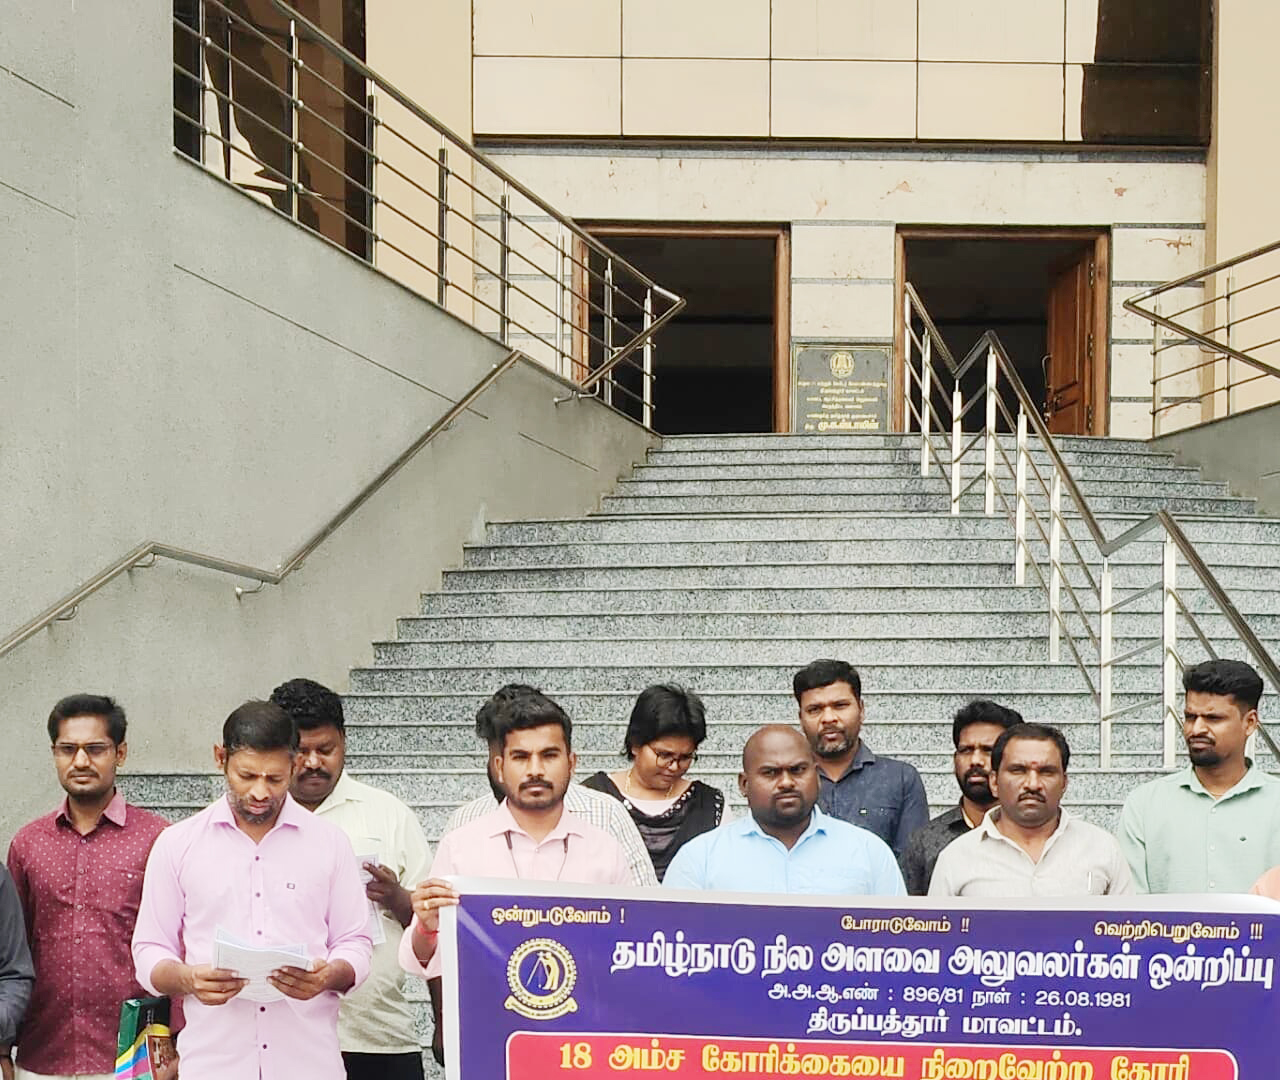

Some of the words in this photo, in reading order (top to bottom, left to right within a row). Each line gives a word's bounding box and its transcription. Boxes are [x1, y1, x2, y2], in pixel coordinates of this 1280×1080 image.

[492, 906, 610, 926] ஒன்றுபடுவோம்
[841, 915, 950, 934] போராடுவோம்
[1094, 920, 1239, 942] வெற்றிபெறுவோம்
[610, 930, 756, 977] தமிழ்நாடு
[761, 933, 813, 978] நில
[820, 942, 939, 976] அளவை
[948, 939, 1140, 987] அலுவலர்கள்
[1149, 945, 1273, 990] ஒன்றிப்பு
[903, 986, 963, 1004] 896/81
[971, 987, 1010, 1008] நாள்
[1035, 990, 1131, 1008] 26.08.1981
[806, 1006, 948, 1037] திருப்பத்தூர்
[963, 1012, 1082, 1036] மாவட்டம்.
[559, 1042, 592, 1069] 18
[609, 1038, 686, 1071] அம்ச
[702, 1042, 904, 1077] கோரிக்கையை
